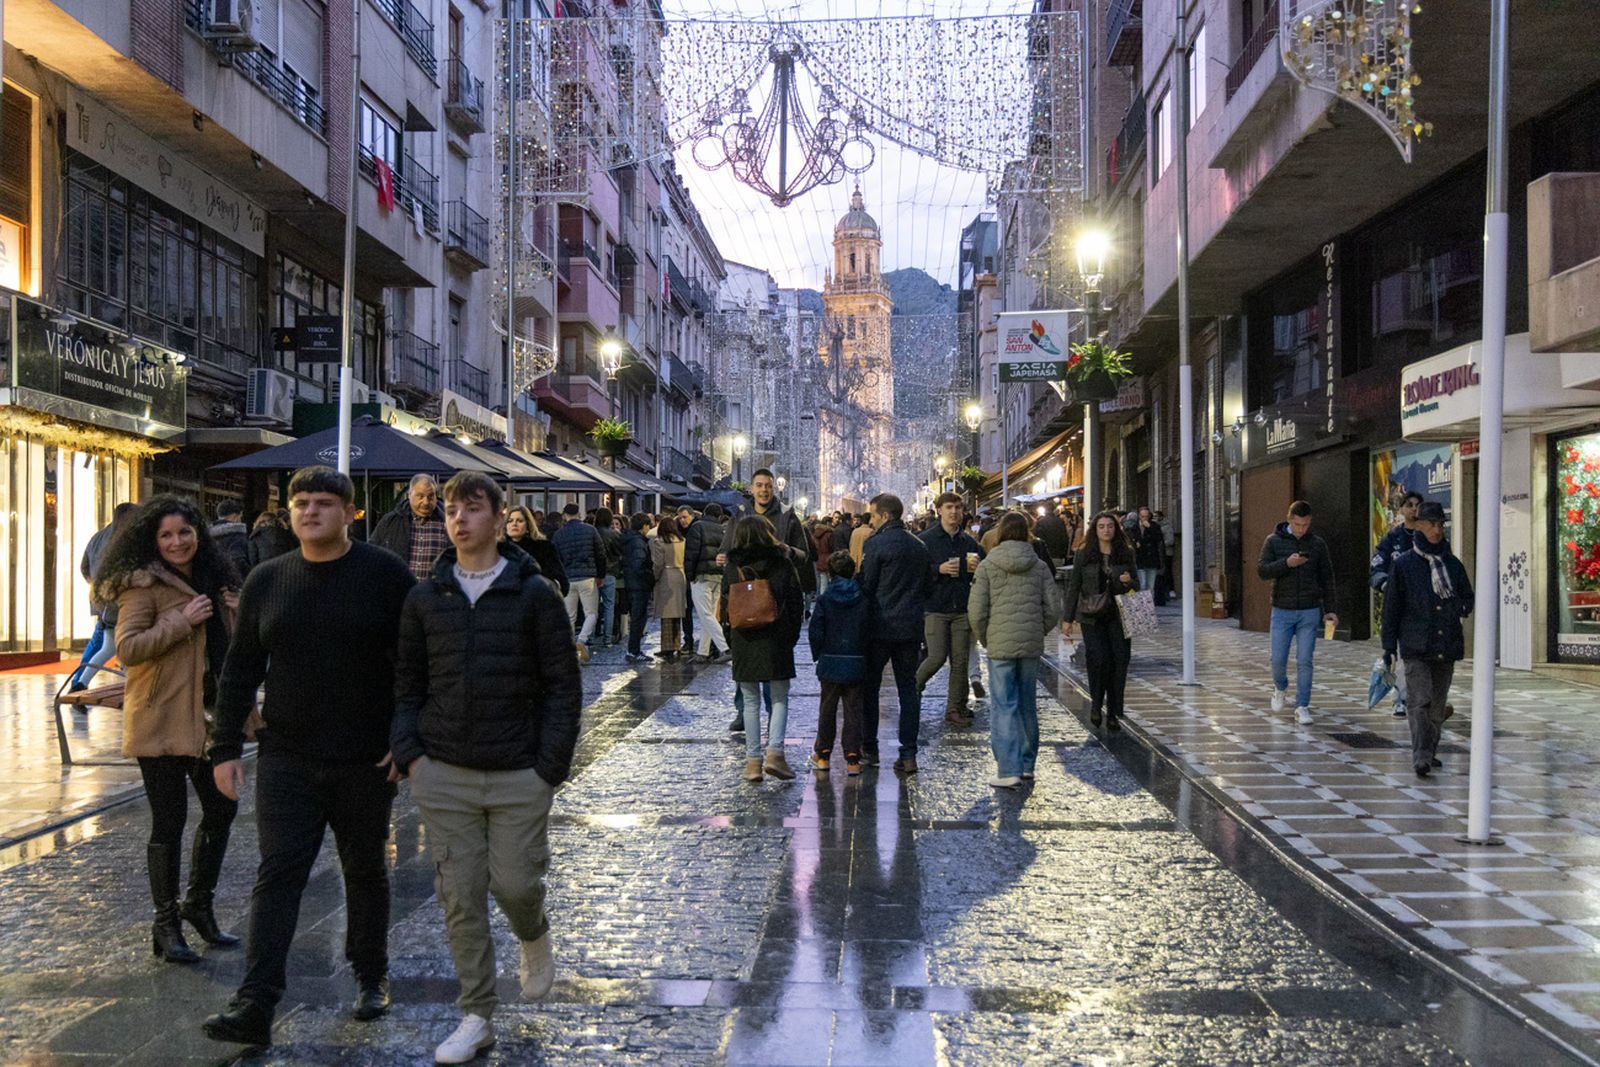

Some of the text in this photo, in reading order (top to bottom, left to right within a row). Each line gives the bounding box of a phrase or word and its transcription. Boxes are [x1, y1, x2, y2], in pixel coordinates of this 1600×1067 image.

[1006, 336, 1024, 345] SAN
[1322, 242, 1335, 433] Restaurante
[46, 329, 120, 377] VERÓNICA
[121, 354, 129, 379] Y
[1009, 362, 1057, 370] DACIA
[1009, 369, 1058, 378] JAPEMASA
[64, 371, 104, 391] DISTRIBUIDOR
[125, 388, 132, 398] DE
